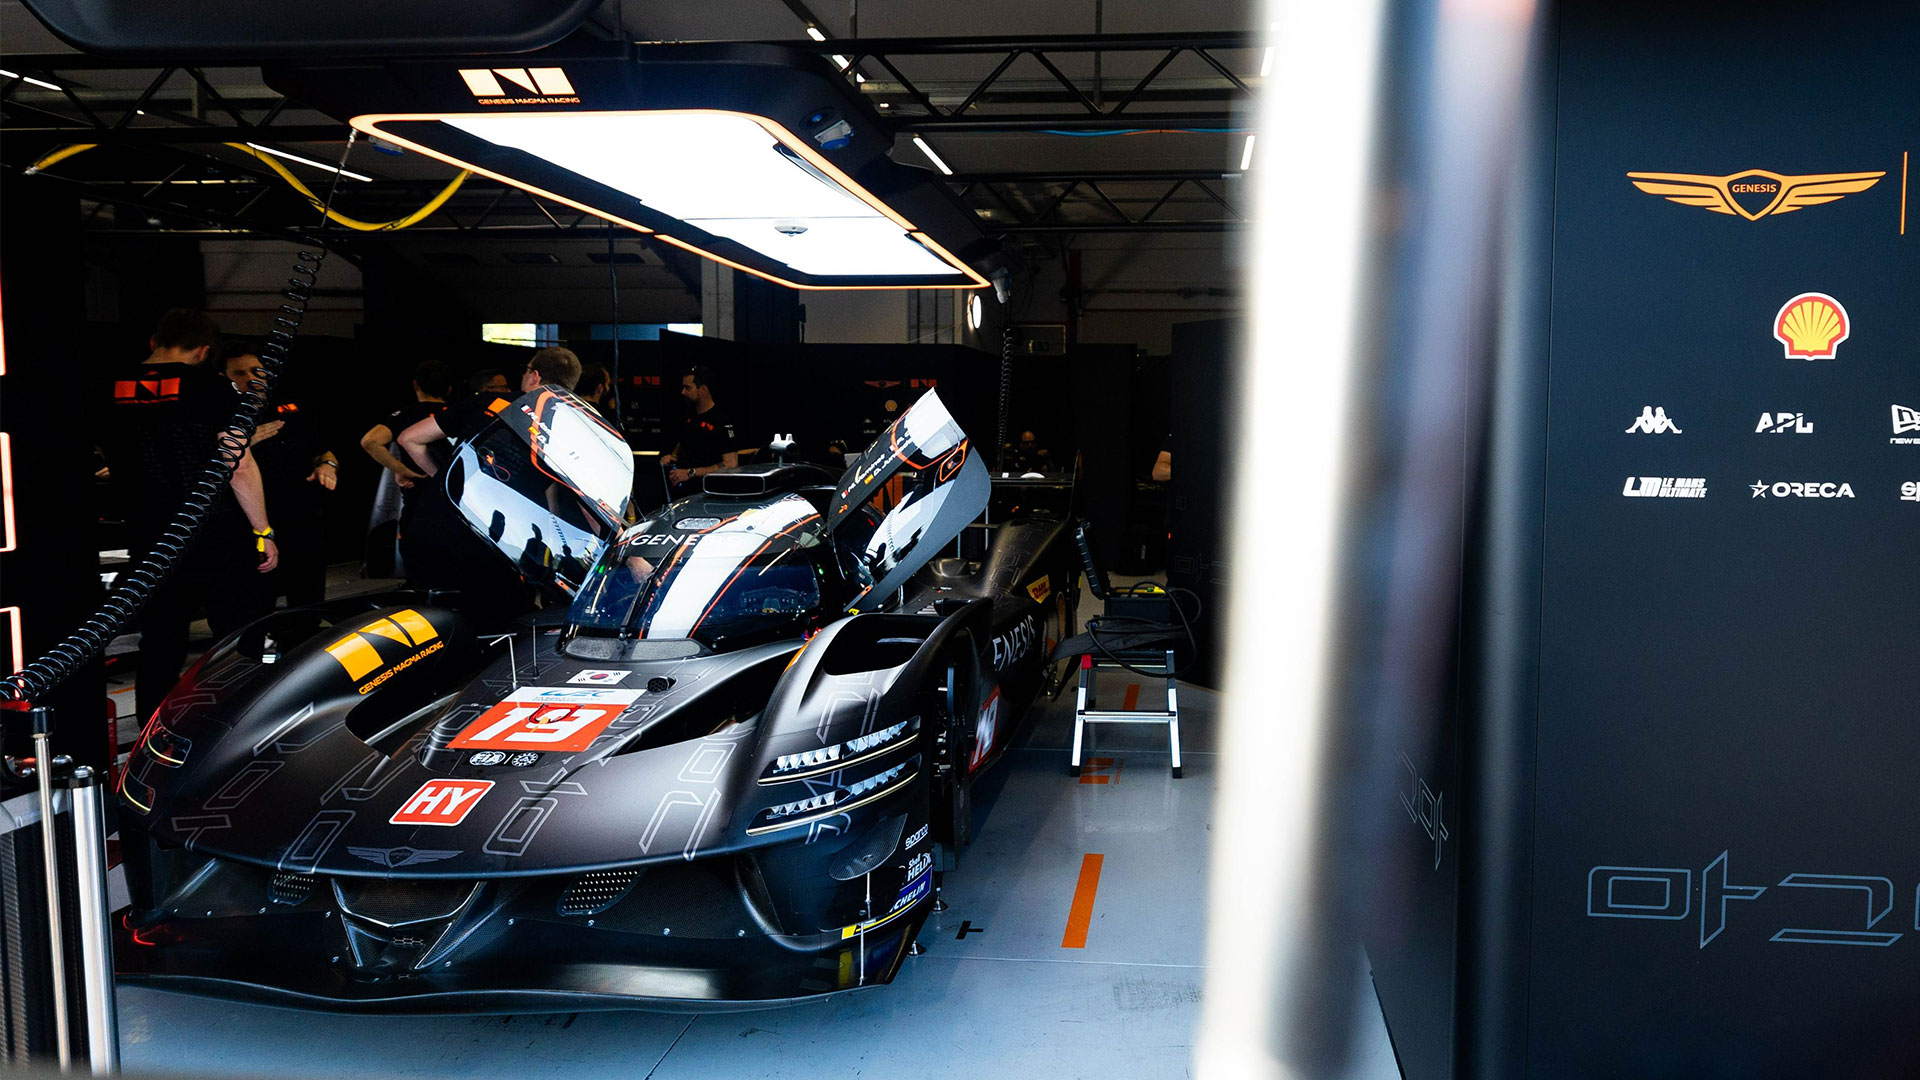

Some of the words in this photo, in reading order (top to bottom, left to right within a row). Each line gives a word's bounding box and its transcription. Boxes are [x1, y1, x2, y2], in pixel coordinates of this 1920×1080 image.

[1732, 183, 1777, 194] GENESIS
[1755, 412, 1814, 434] APL
[1659, 487, 1708, 498] ULTIMATE
[1662, 477, 1675, 488] LE
[1674, 477, 1706, 488] MANS
[1771, 481, 1856, 498] ORECA
[992, 614, 1036, 672] ENESIS
[358, 668, 394, 695] GENESIS
[393, 653, 422, 674] MAGMA
[420, 640, 444, 659] RACING
[468, 706, 608, 743] 19
[470, 751, 504, 766] FIA
[402, 786, 484, 815] HY
[905, 824, 929, 850] sparco
[907, 853, 932, 882] HELIX
[908, 853, 921, 869] Shell
[889, 881, 926, 913] CHELIN
